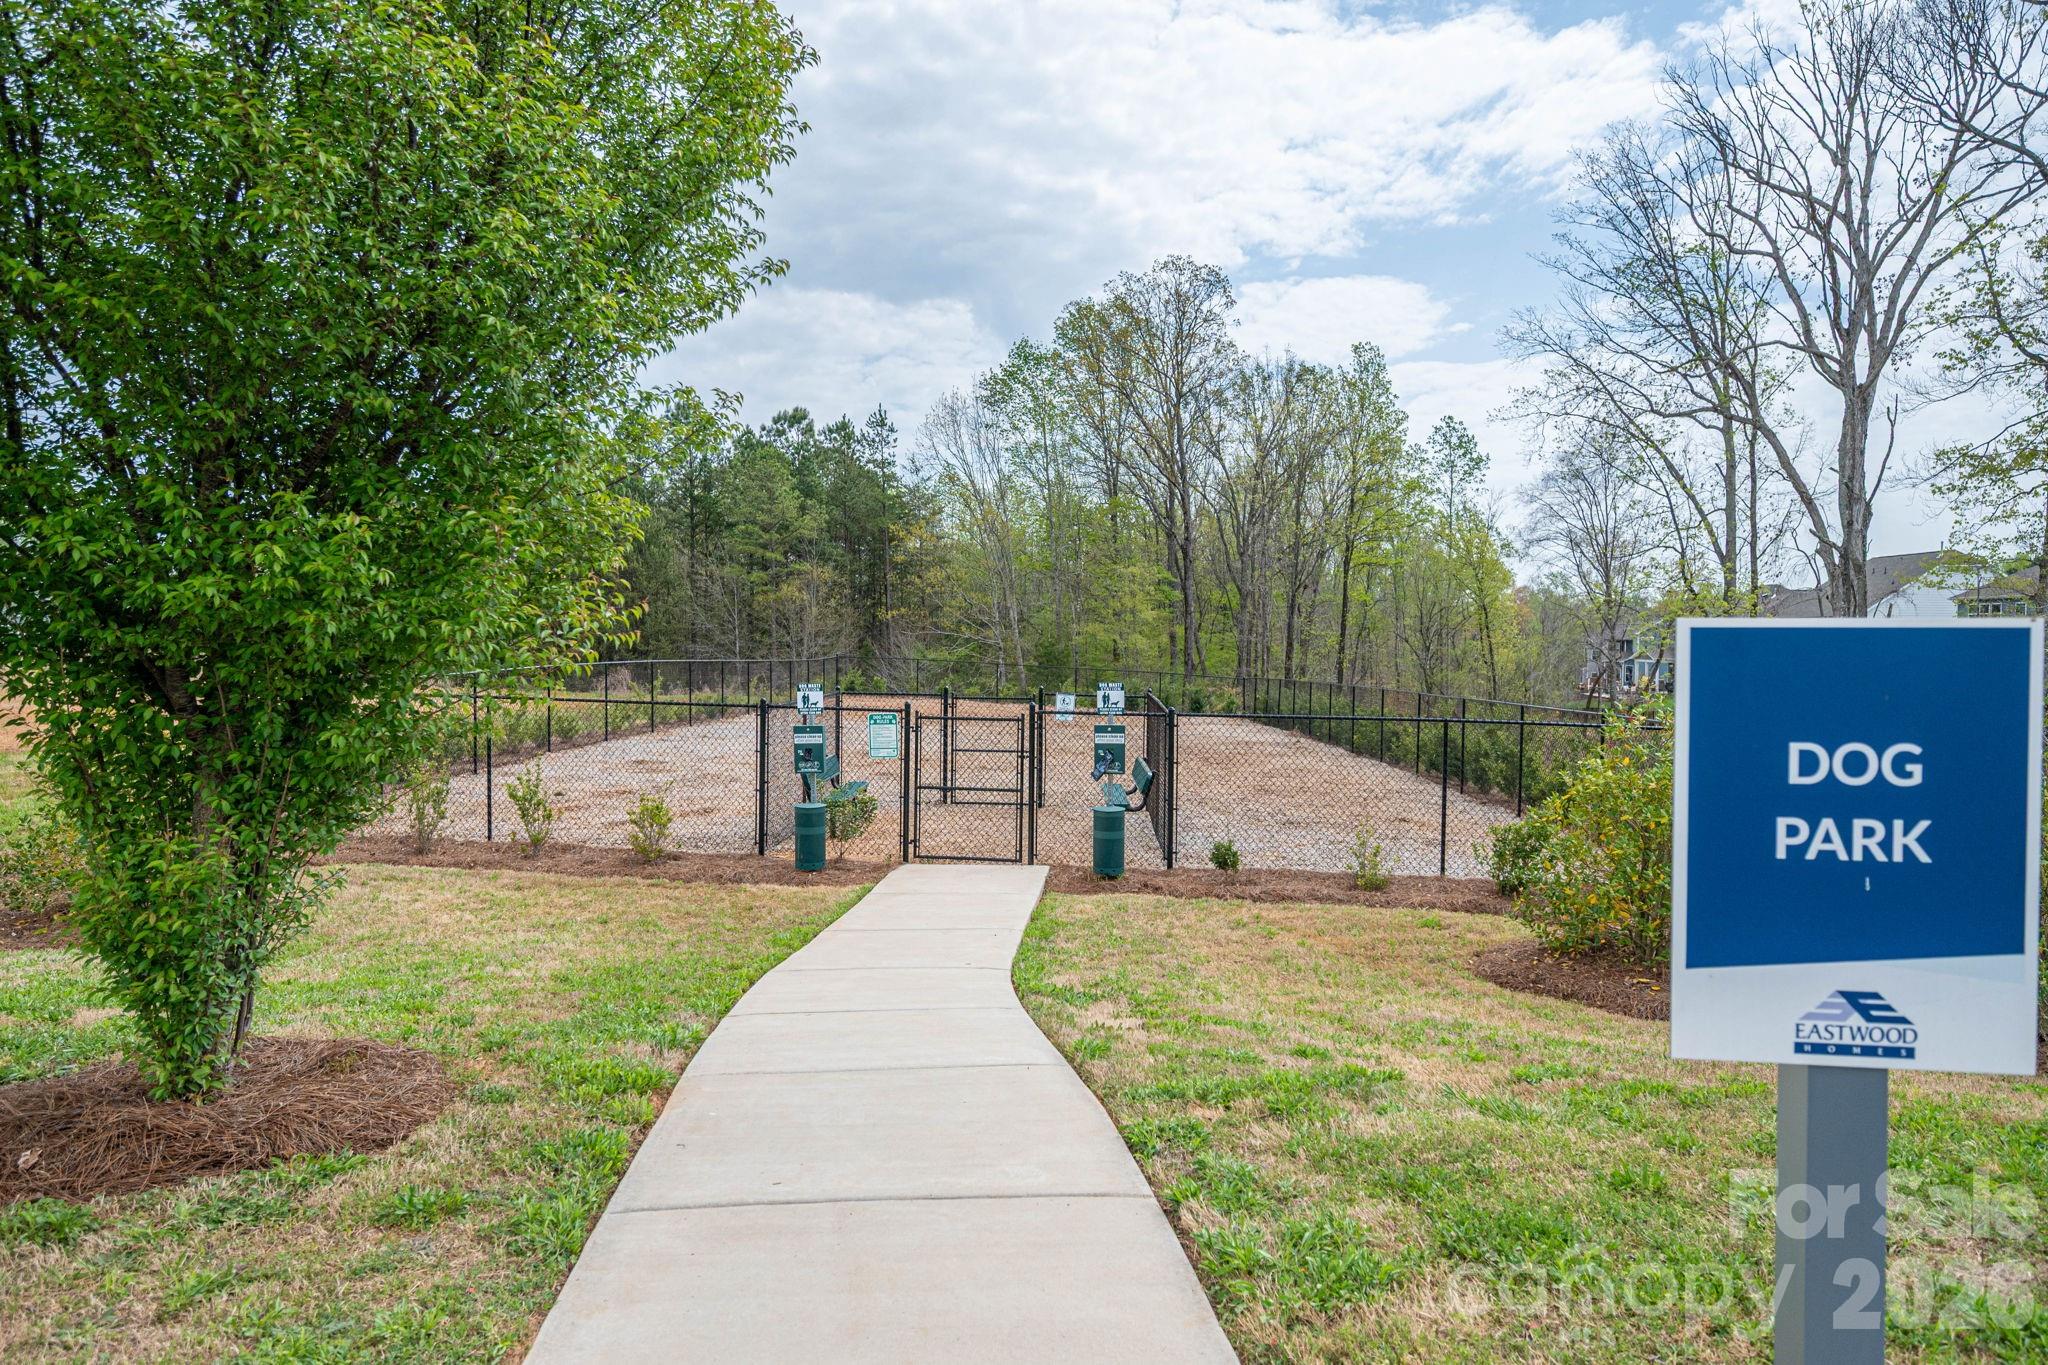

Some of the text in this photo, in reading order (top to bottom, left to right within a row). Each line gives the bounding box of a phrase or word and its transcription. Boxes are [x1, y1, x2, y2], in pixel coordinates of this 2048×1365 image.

[1787, 741, 1923, 787] DOG
[1775, 816, 1932, 864] PARK
[1795, 1023, 1918, 1044] EASTWOOD
[1803, 1044, 1907, 1057] HOMES
